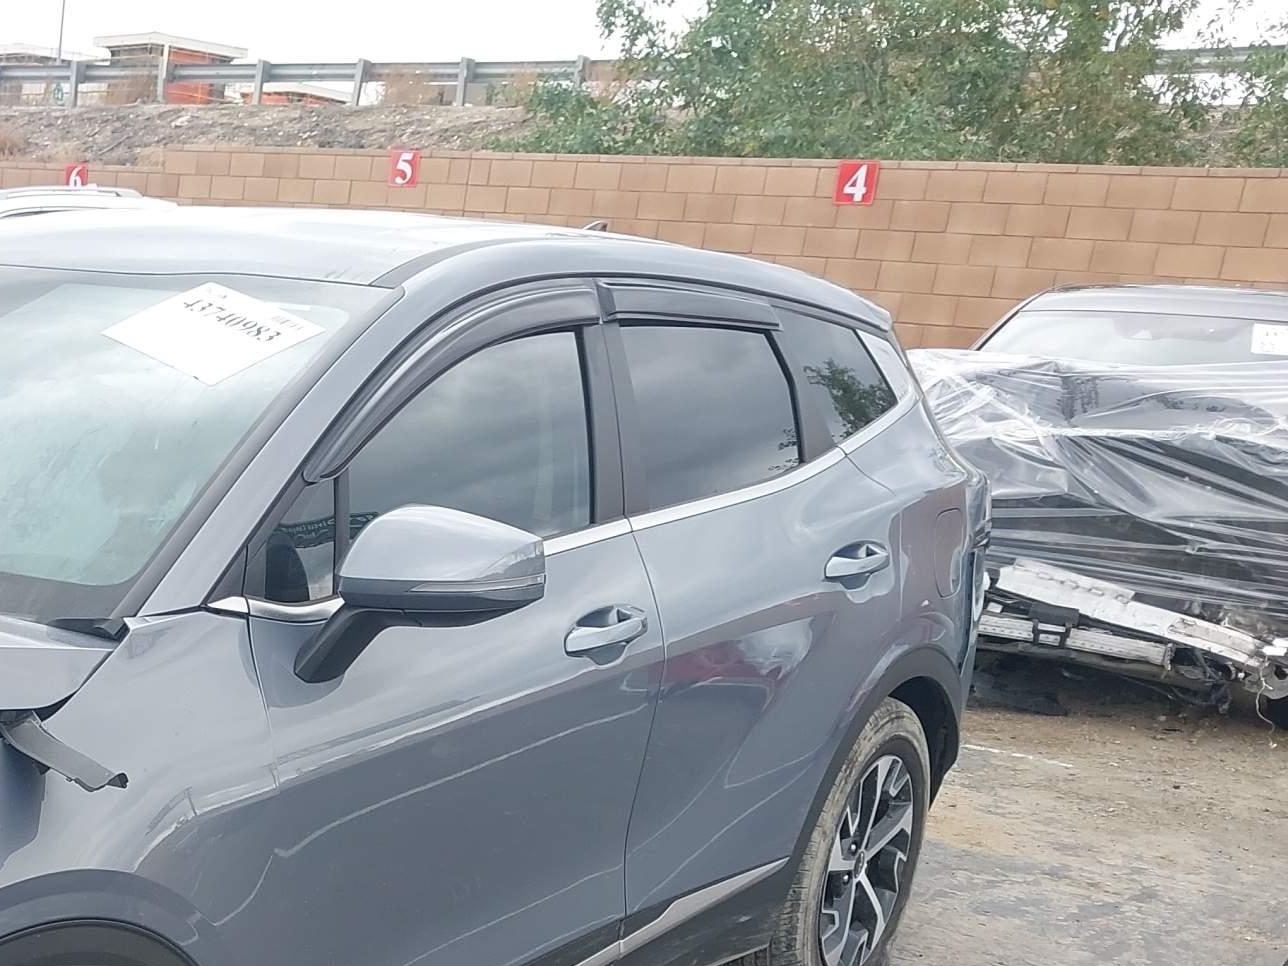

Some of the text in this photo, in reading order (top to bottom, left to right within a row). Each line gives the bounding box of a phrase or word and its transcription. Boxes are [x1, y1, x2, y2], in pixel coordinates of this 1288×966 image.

[69, 166, 82, 189] 6
[395, 152, 414, 185] 5
[842, 164, 868, 202] 4
[183, 299, 281, 341] 43740983
